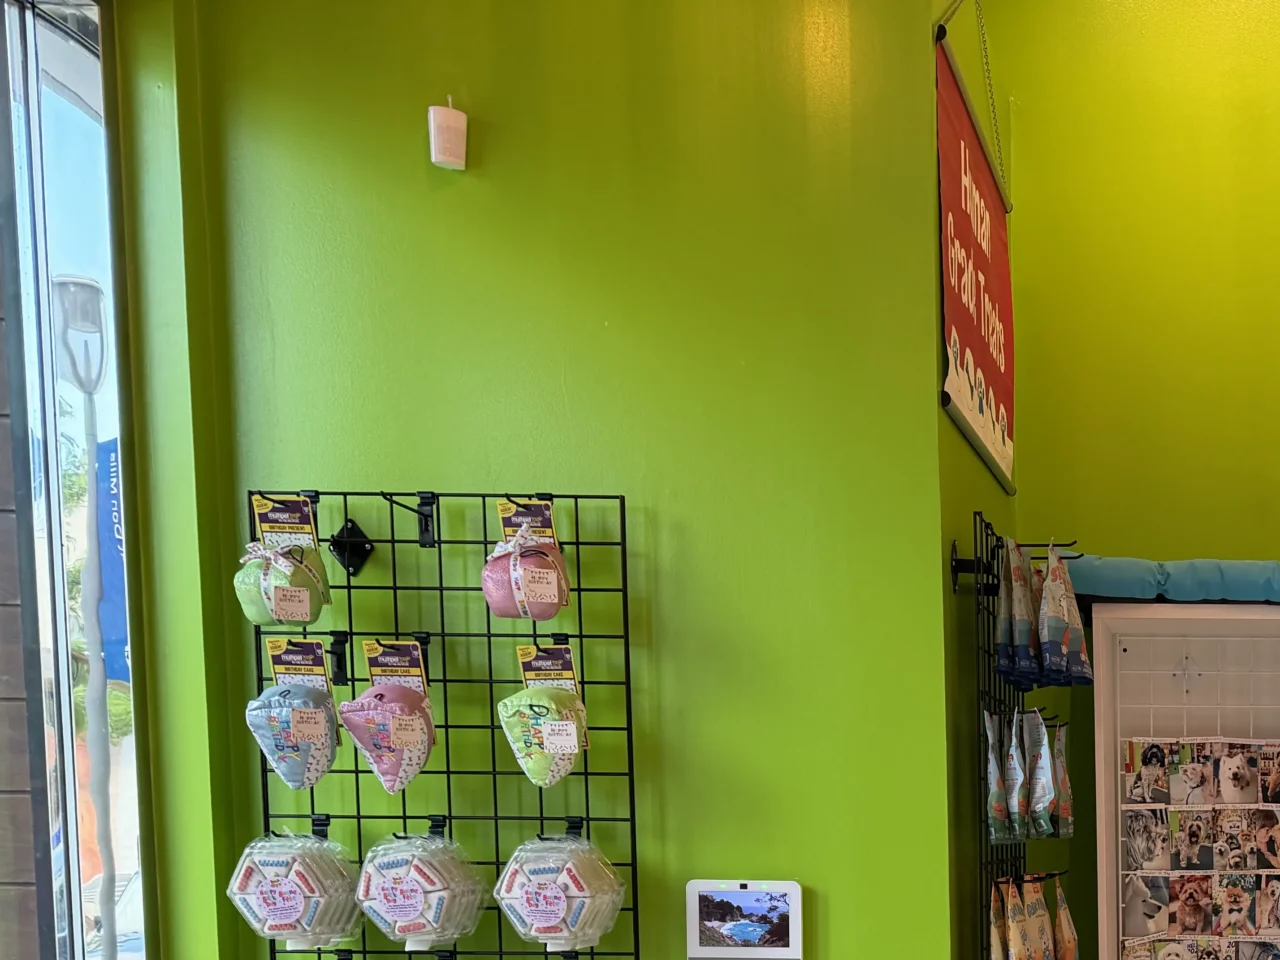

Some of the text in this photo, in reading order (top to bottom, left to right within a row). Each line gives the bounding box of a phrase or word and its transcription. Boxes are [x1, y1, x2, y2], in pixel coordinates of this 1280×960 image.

[960, 139, 991, 262] Human
[947, 211, 1005, 373] Grade Treats
